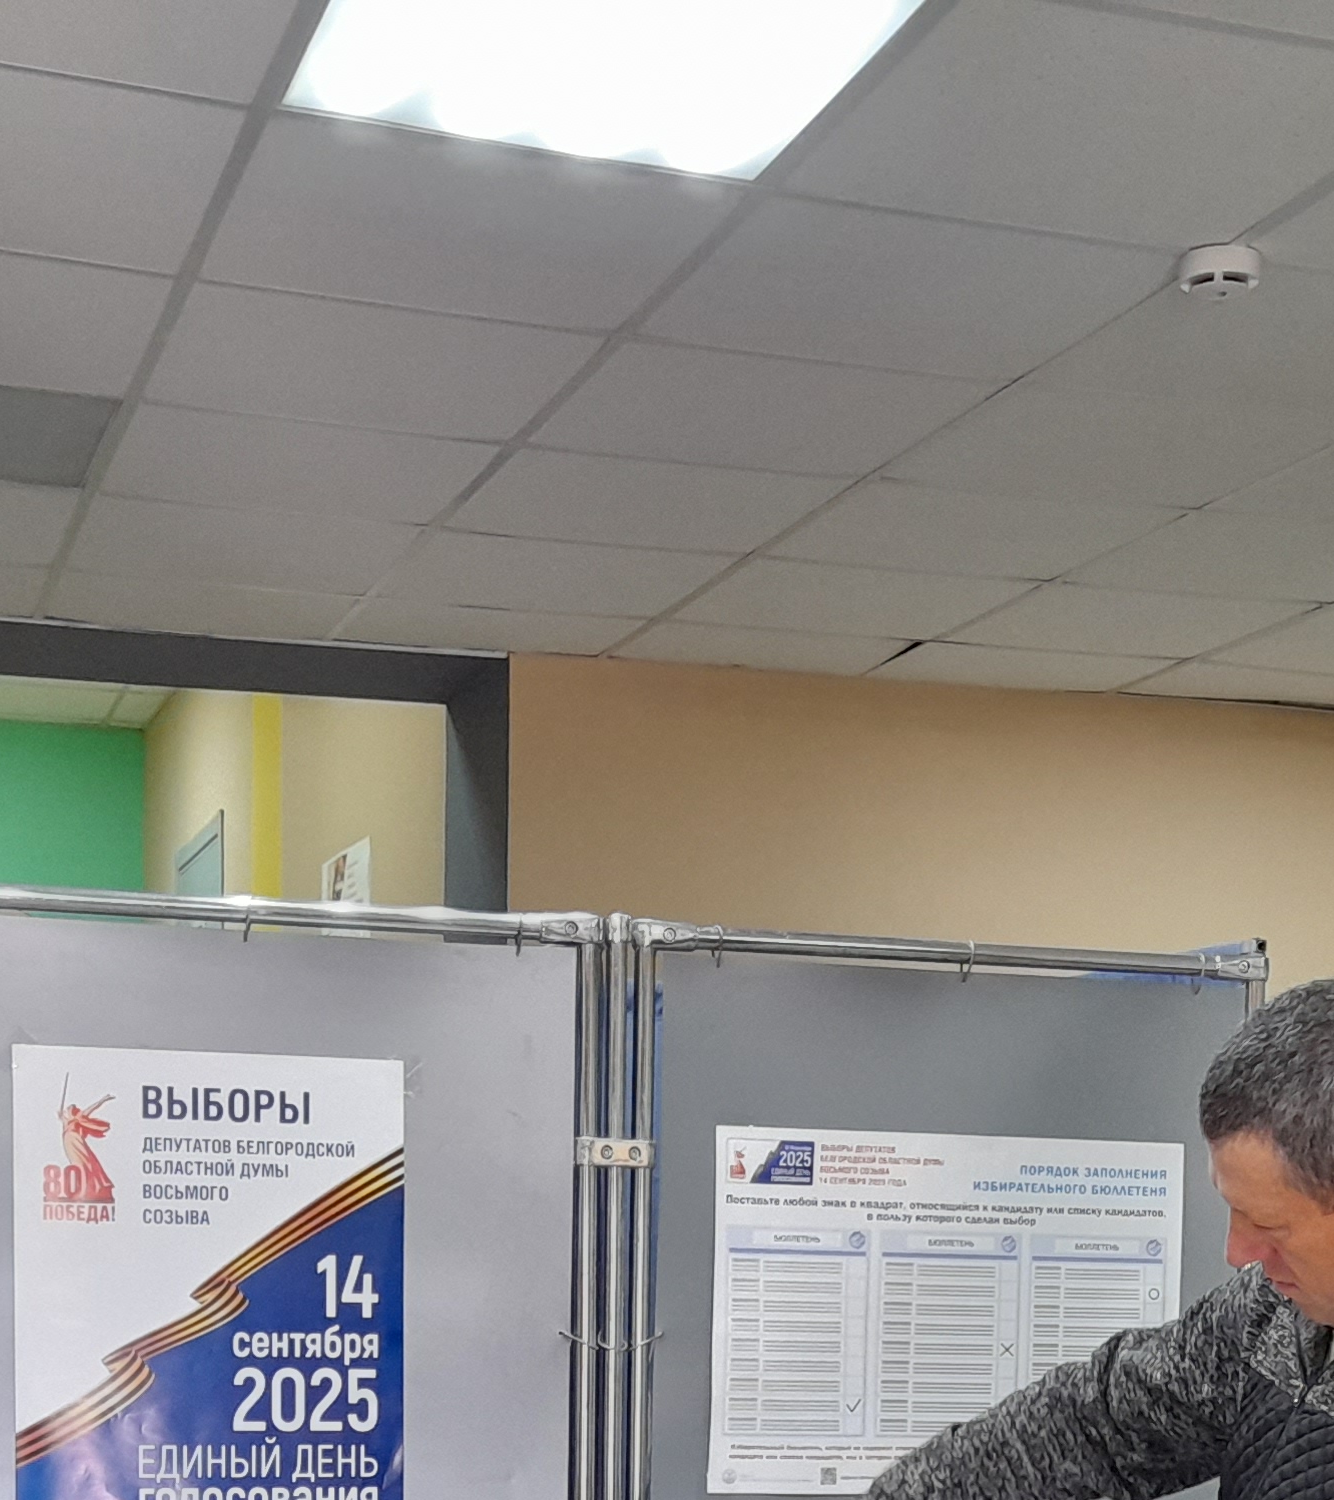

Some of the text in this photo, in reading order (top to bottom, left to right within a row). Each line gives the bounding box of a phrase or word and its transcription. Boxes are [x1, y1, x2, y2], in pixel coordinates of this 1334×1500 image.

[142, 1085, 310, 1125] ВЫБОРЫ
[142, 1137, 355, 1159] ДЕПУТАТОВ БЕЛГОРОДСКОЙ
[779, 1150, 812, 1167] 2025
[142, 1159, 289, 1179] ОБЛАСТНОЙ ДУМЫ
[1020, 1164, 1167, 1180] ПОРЯДОК ЗАПОЛНЕНИЯ
[43, 1164, 82, 1199] 80
[973, 1181, 1167, 1197] ИЗБИРАТЕЛЬНОГО БЮЛЛЕТЕНЯ
[142, 1184, 229, 1201] ВОСЬМОГО
[43, 1204, 115, 1224] ПОБЕДА!
[142, 1208, 210, 1225] СОЗЫВА
[726, 1194, 780, 1206] Поставьте
[782, 1196, 817, 1207] любой
[821, 1199, 847, 1208] знак
[1046, 1206, 1065, 1214] или
[1067, 1207, 1102, 1218] списку
[1003, 1214, 1036, 1227] выбор
[317, 1254, 379, 1319] 14
[232, 1324, 379, 1366] сентября
[233, 1367, 379, 1432] 2025
[138, 1436, 379, 1484] ЕДИНЫЙ ДЕНЬ
